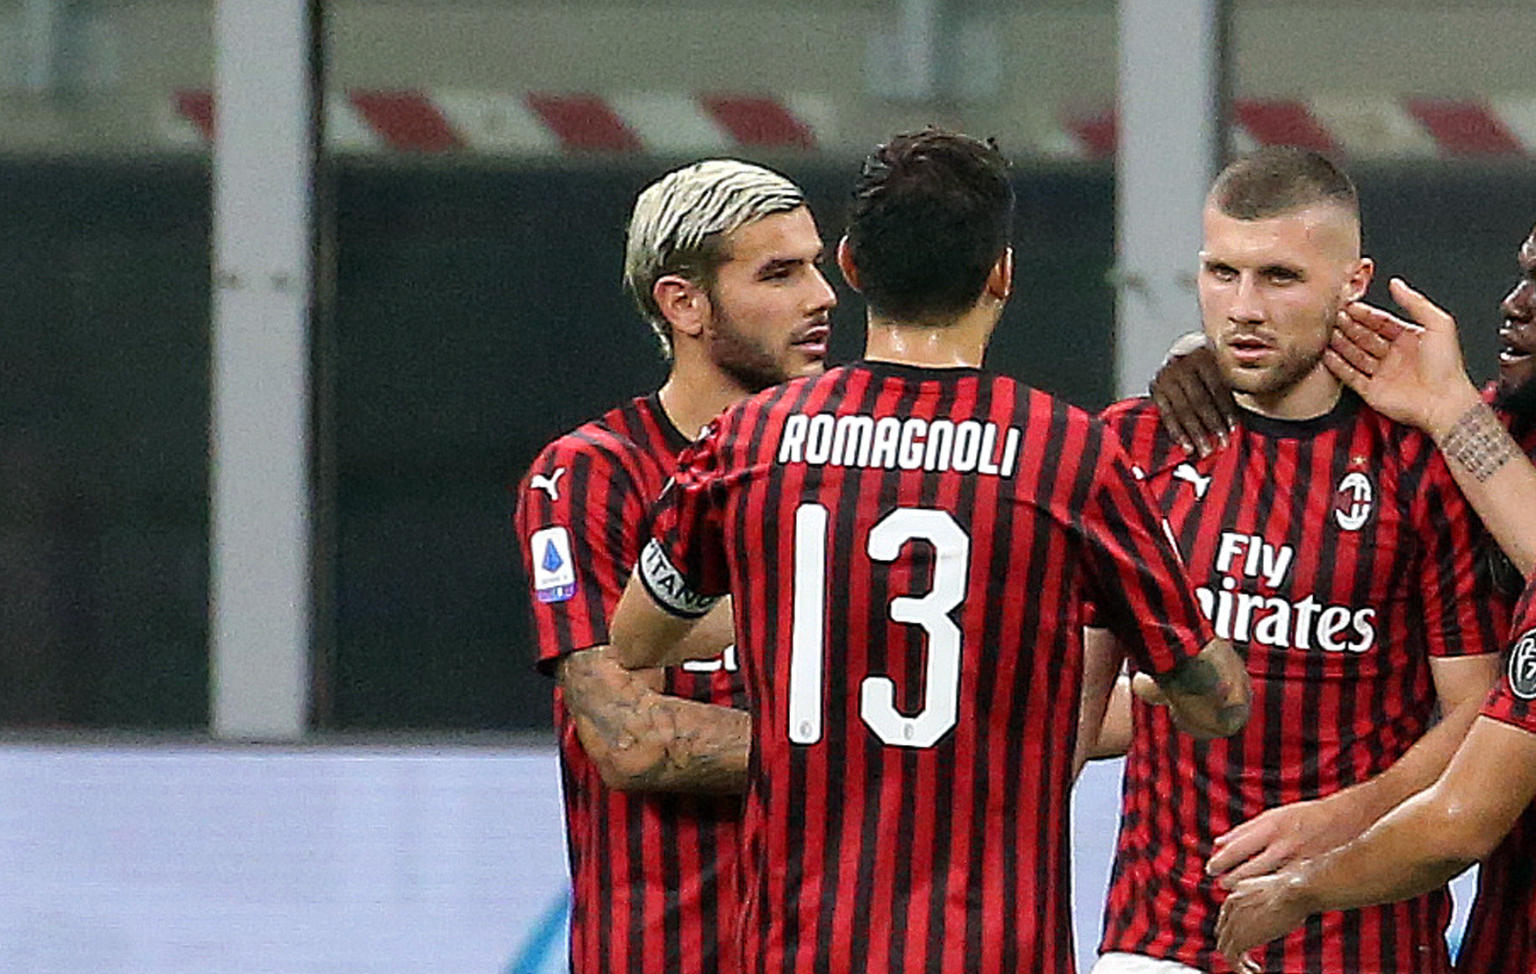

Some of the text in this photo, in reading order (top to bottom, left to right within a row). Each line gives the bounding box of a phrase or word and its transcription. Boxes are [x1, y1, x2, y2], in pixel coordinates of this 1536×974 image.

[777, 413, 1020, 478] ROMAGNOLI
[1216, 532, 1293, 588] Fly
[788, 503, 970, 748] 13
[1195, 576, 1376, 653] irates
